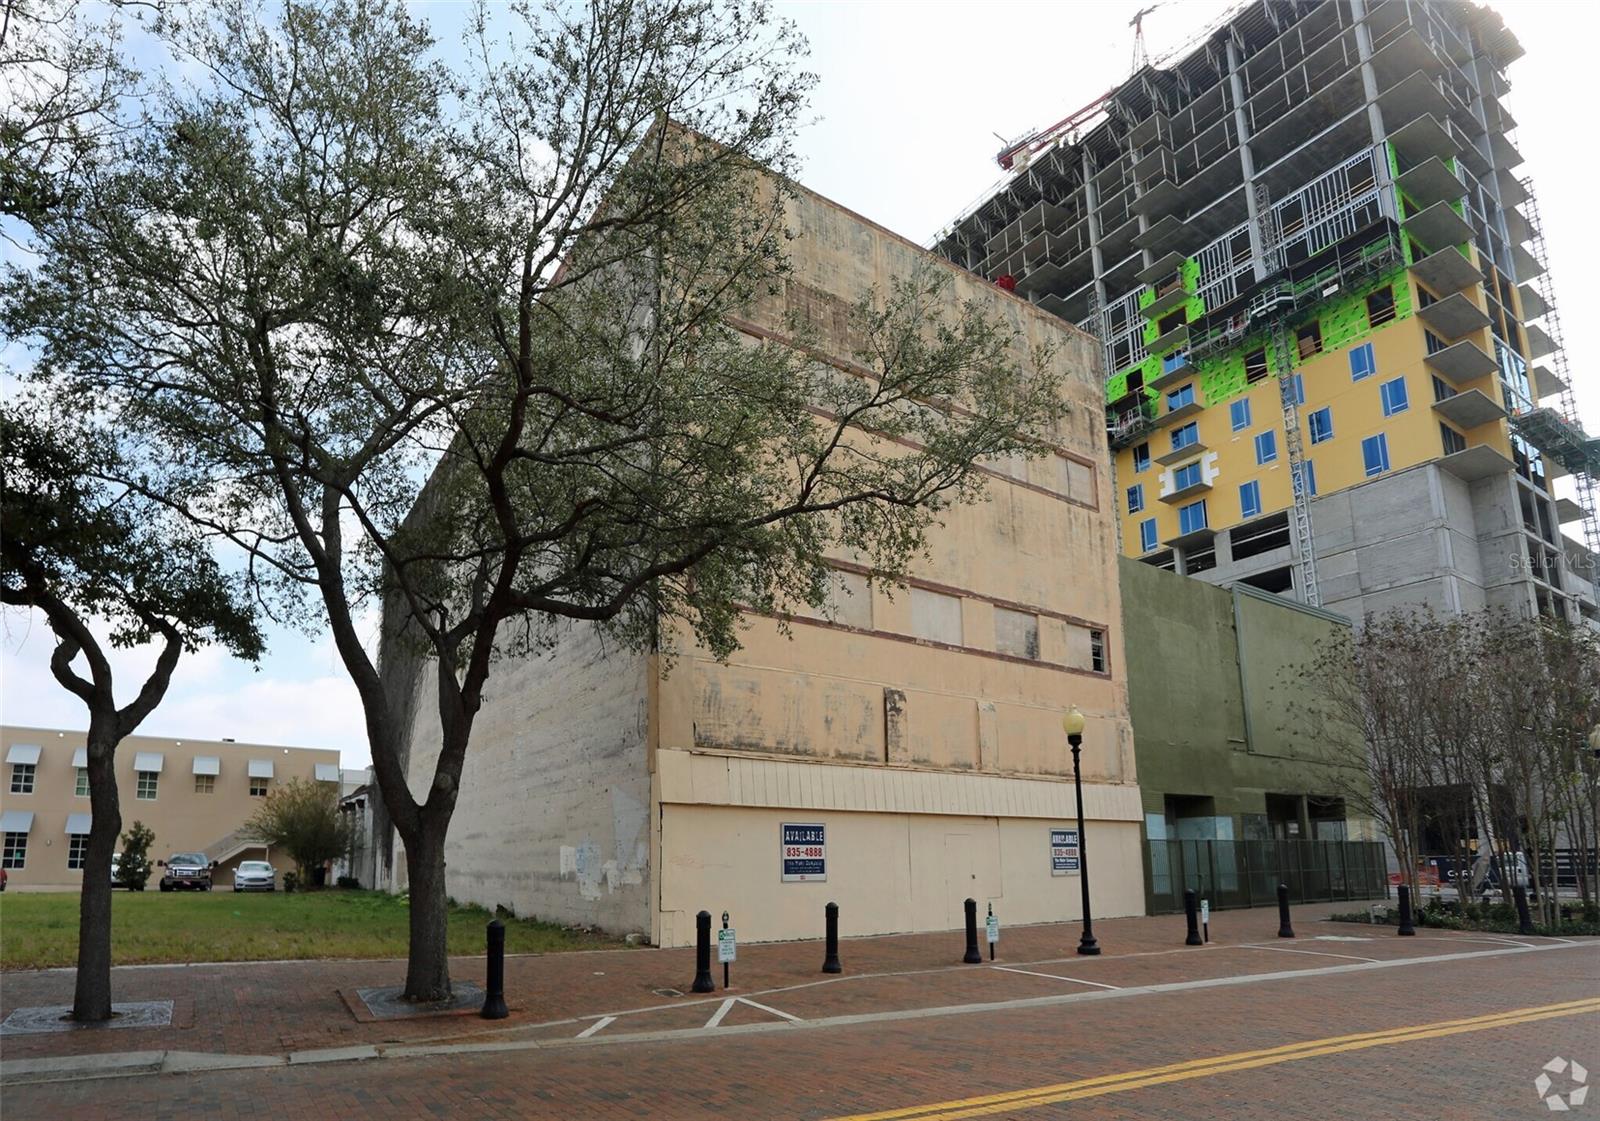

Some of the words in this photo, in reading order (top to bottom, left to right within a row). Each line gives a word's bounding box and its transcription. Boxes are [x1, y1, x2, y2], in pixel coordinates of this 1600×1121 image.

[785, 831, 824, 841] AVAILABLE
[1052, 834, 1077, 844] AVAILABLE
[786, 847, 823, 857] 835-4888
